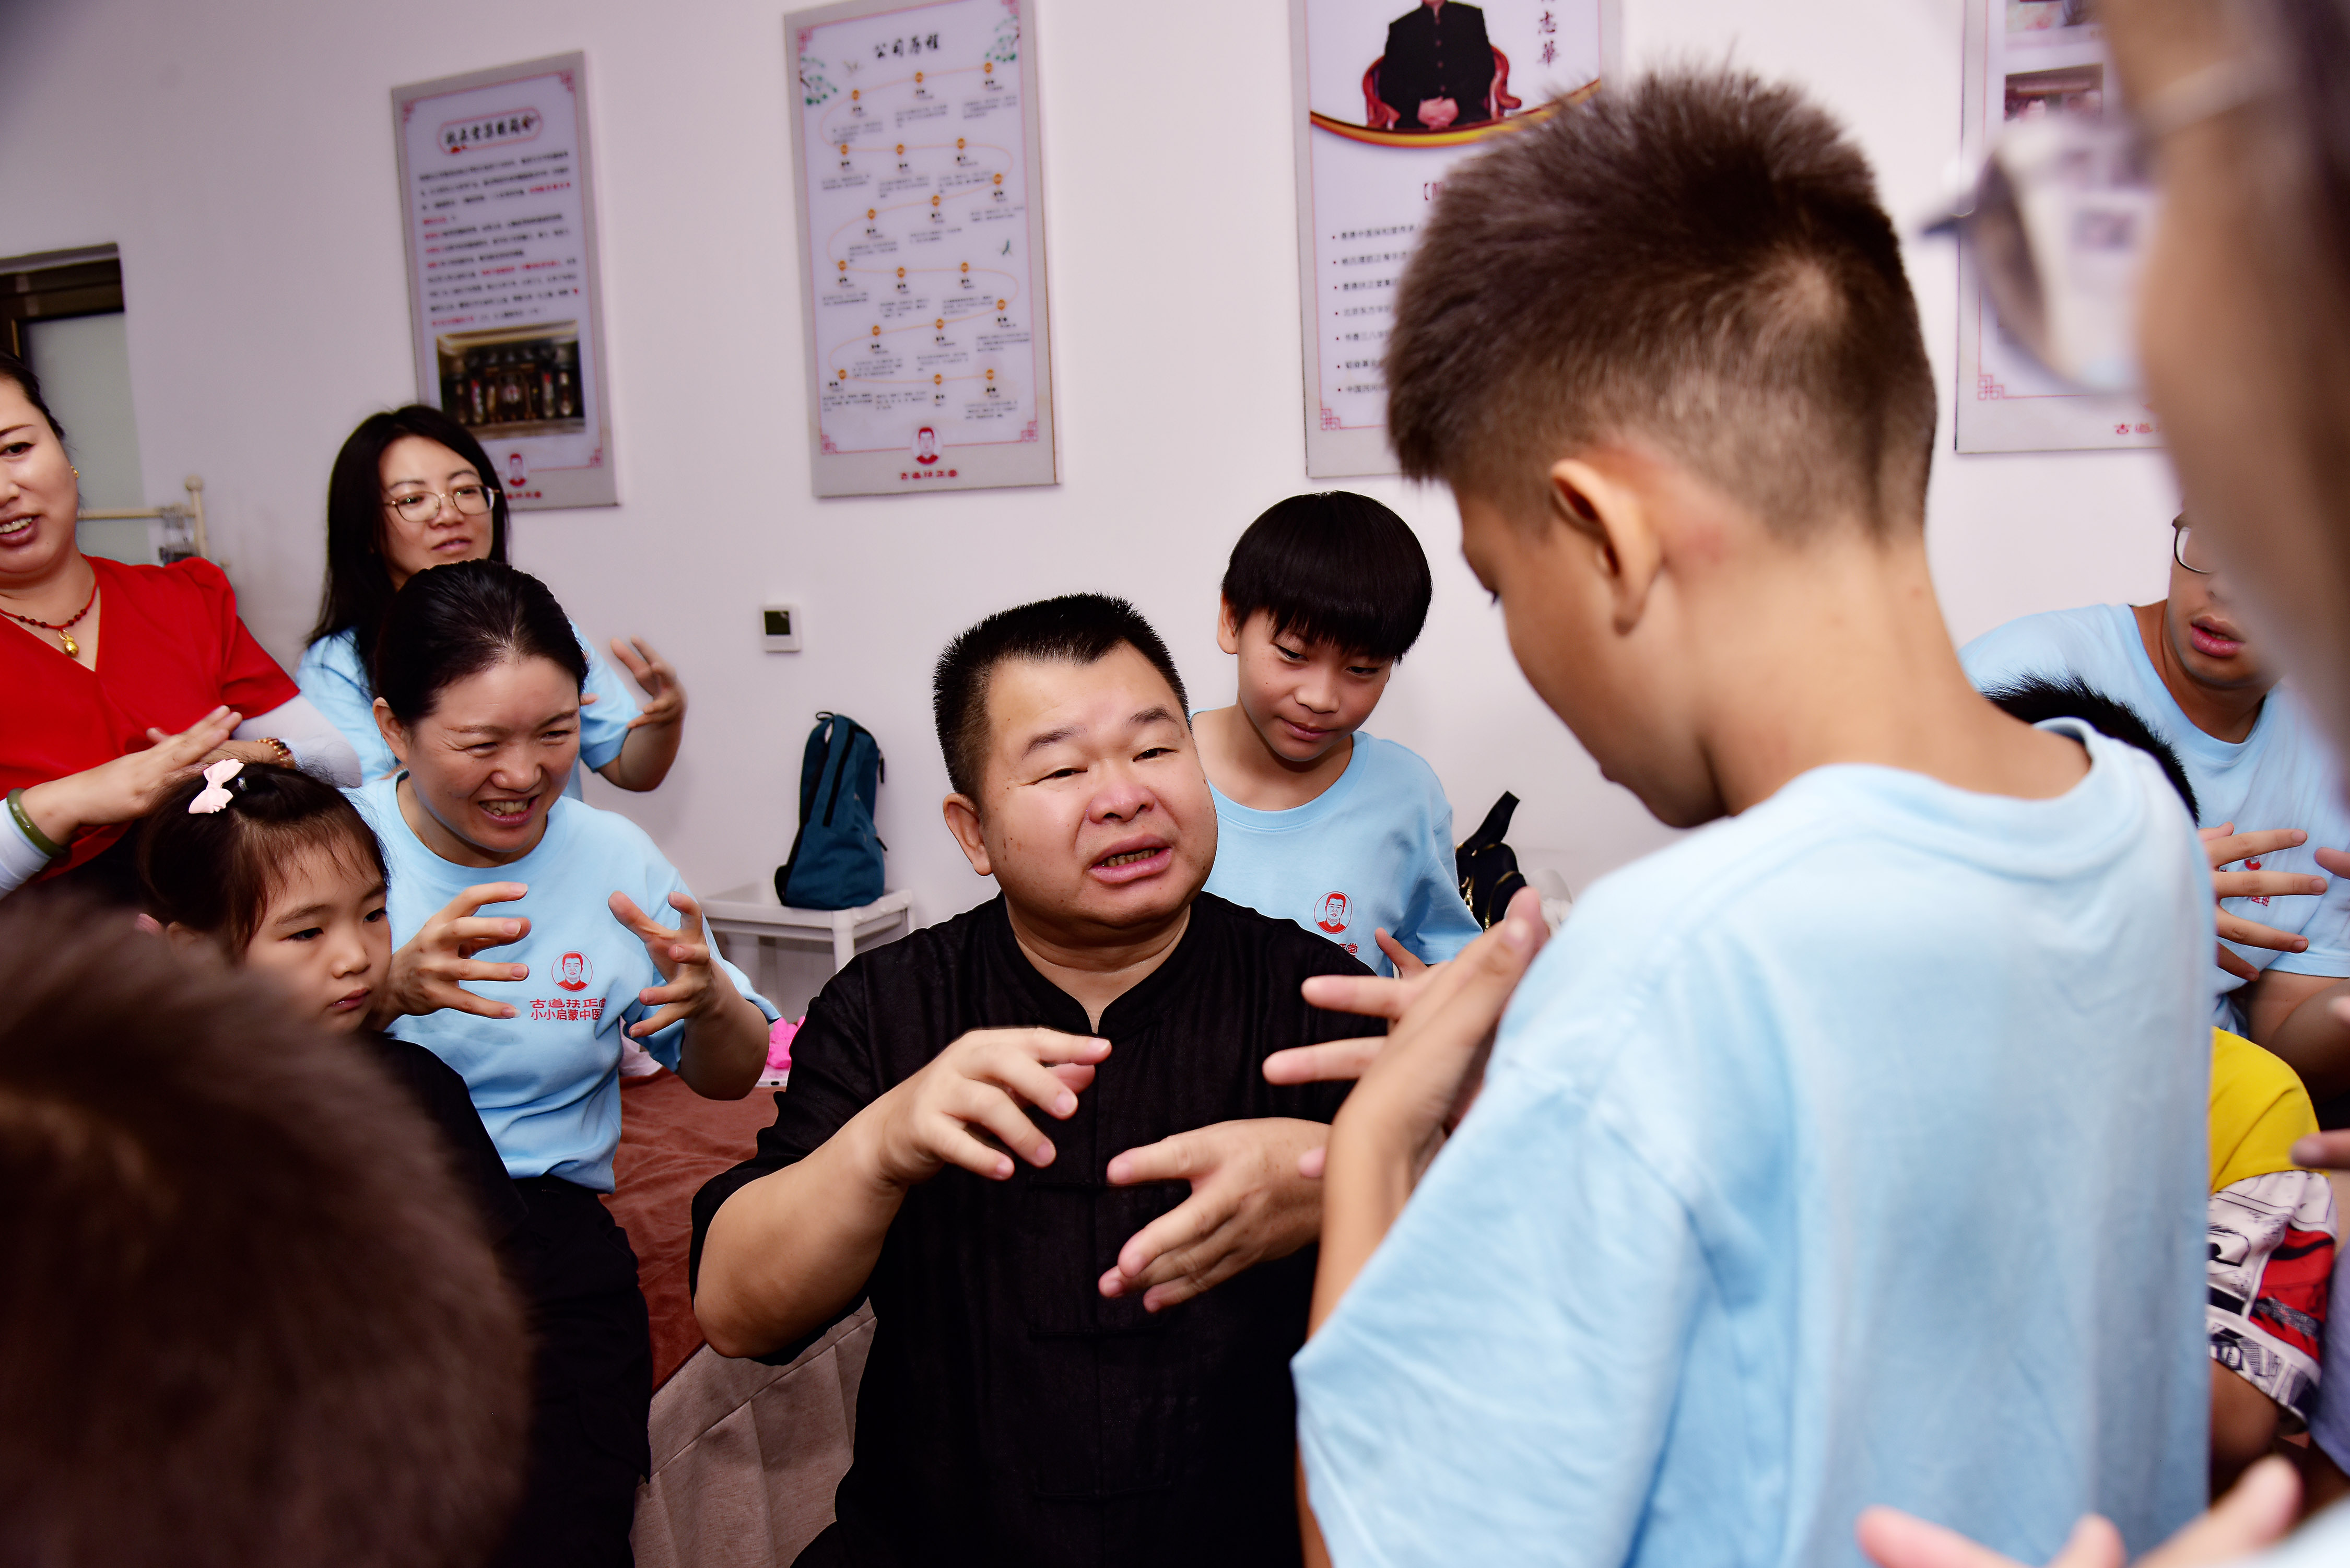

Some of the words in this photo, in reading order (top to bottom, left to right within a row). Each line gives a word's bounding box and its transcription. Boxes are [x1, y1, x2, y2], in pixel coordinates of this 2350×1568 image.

[1537, 0, 1560, 67] 志華
[2113, 422, 2160, 434] 古道
[531, 1009, 603, 1021] 小小启蒙中医
